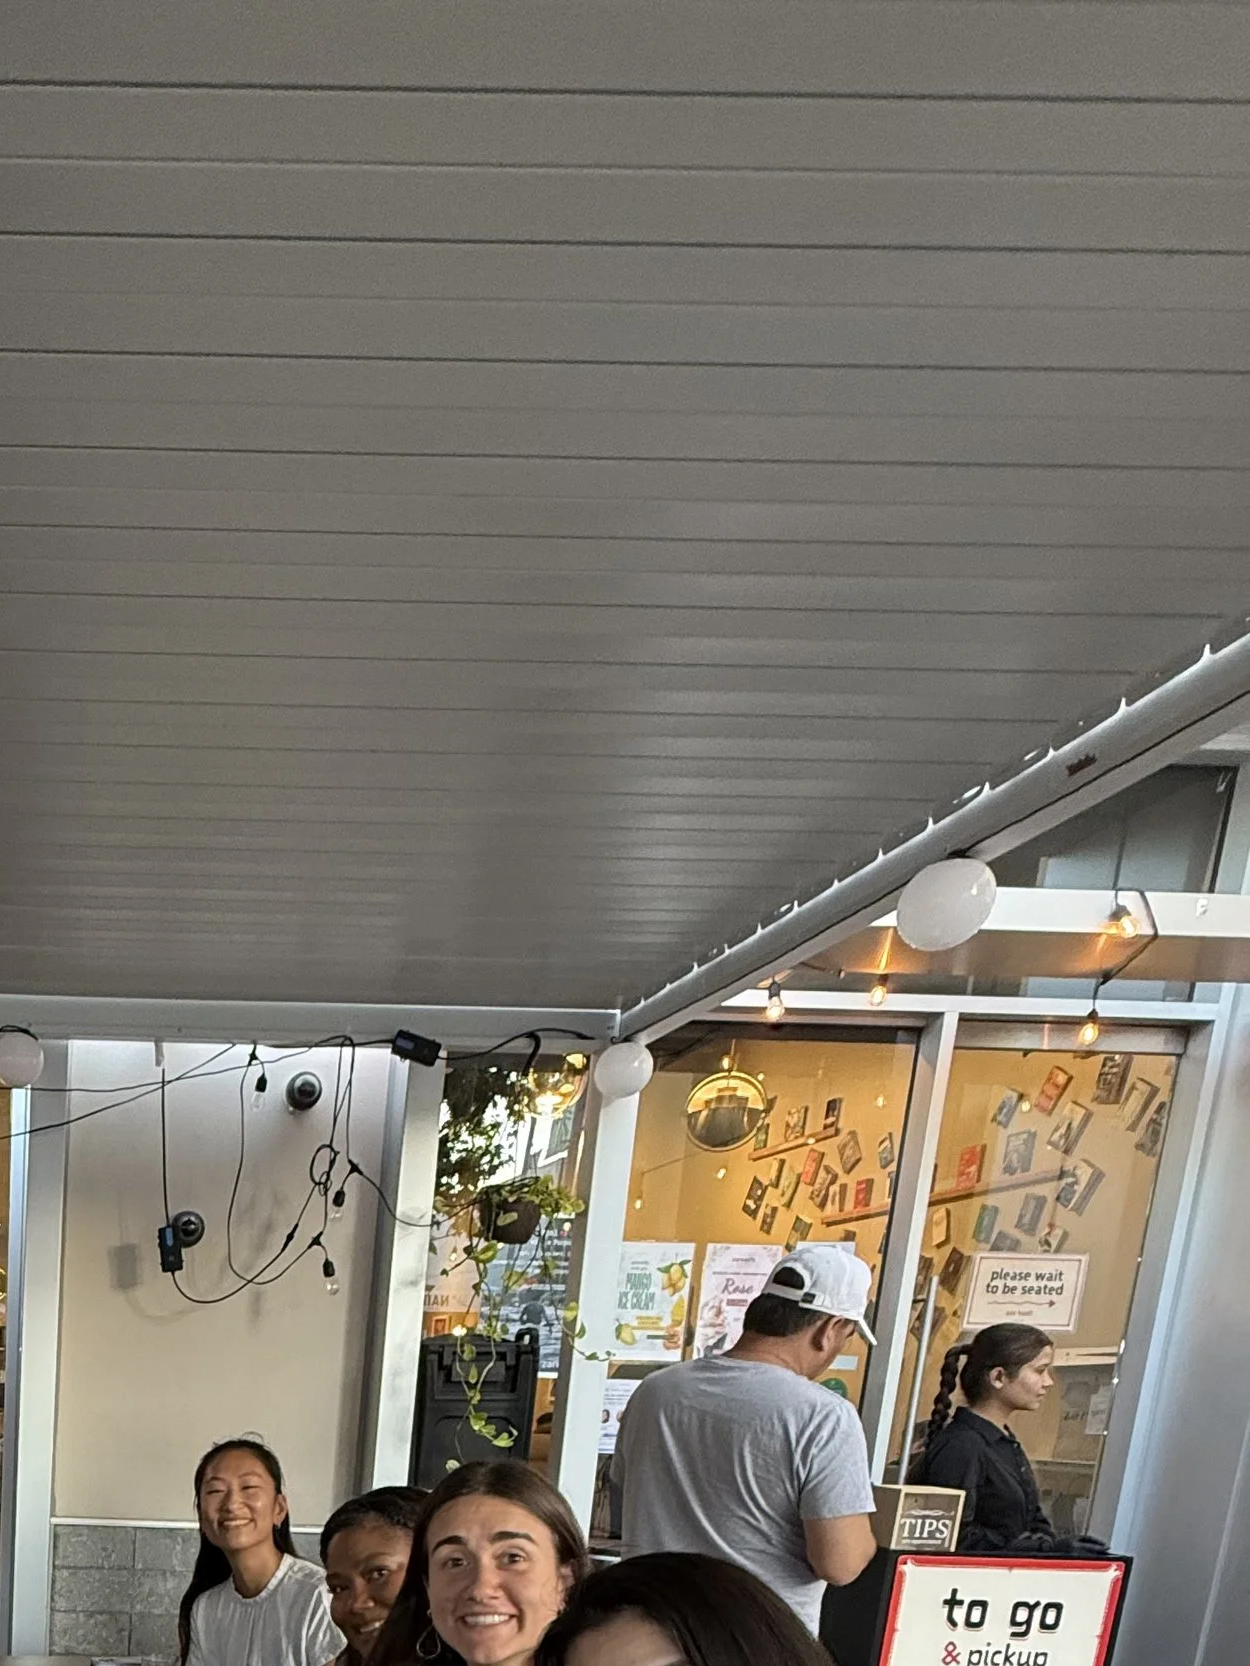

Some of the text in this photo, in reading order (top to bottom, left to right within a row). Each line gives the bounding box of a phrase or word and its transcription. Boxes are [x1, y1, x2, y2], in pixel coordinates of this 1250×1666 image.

[990, 1268, 1064, 1282] please wait
[985, 1282, 1064, 1295] to be seated
[900, 1517, 951, 1539] TIPS
[942, 1588, 1064, 1639] to go
[941, 1641, 961, 1666] &
